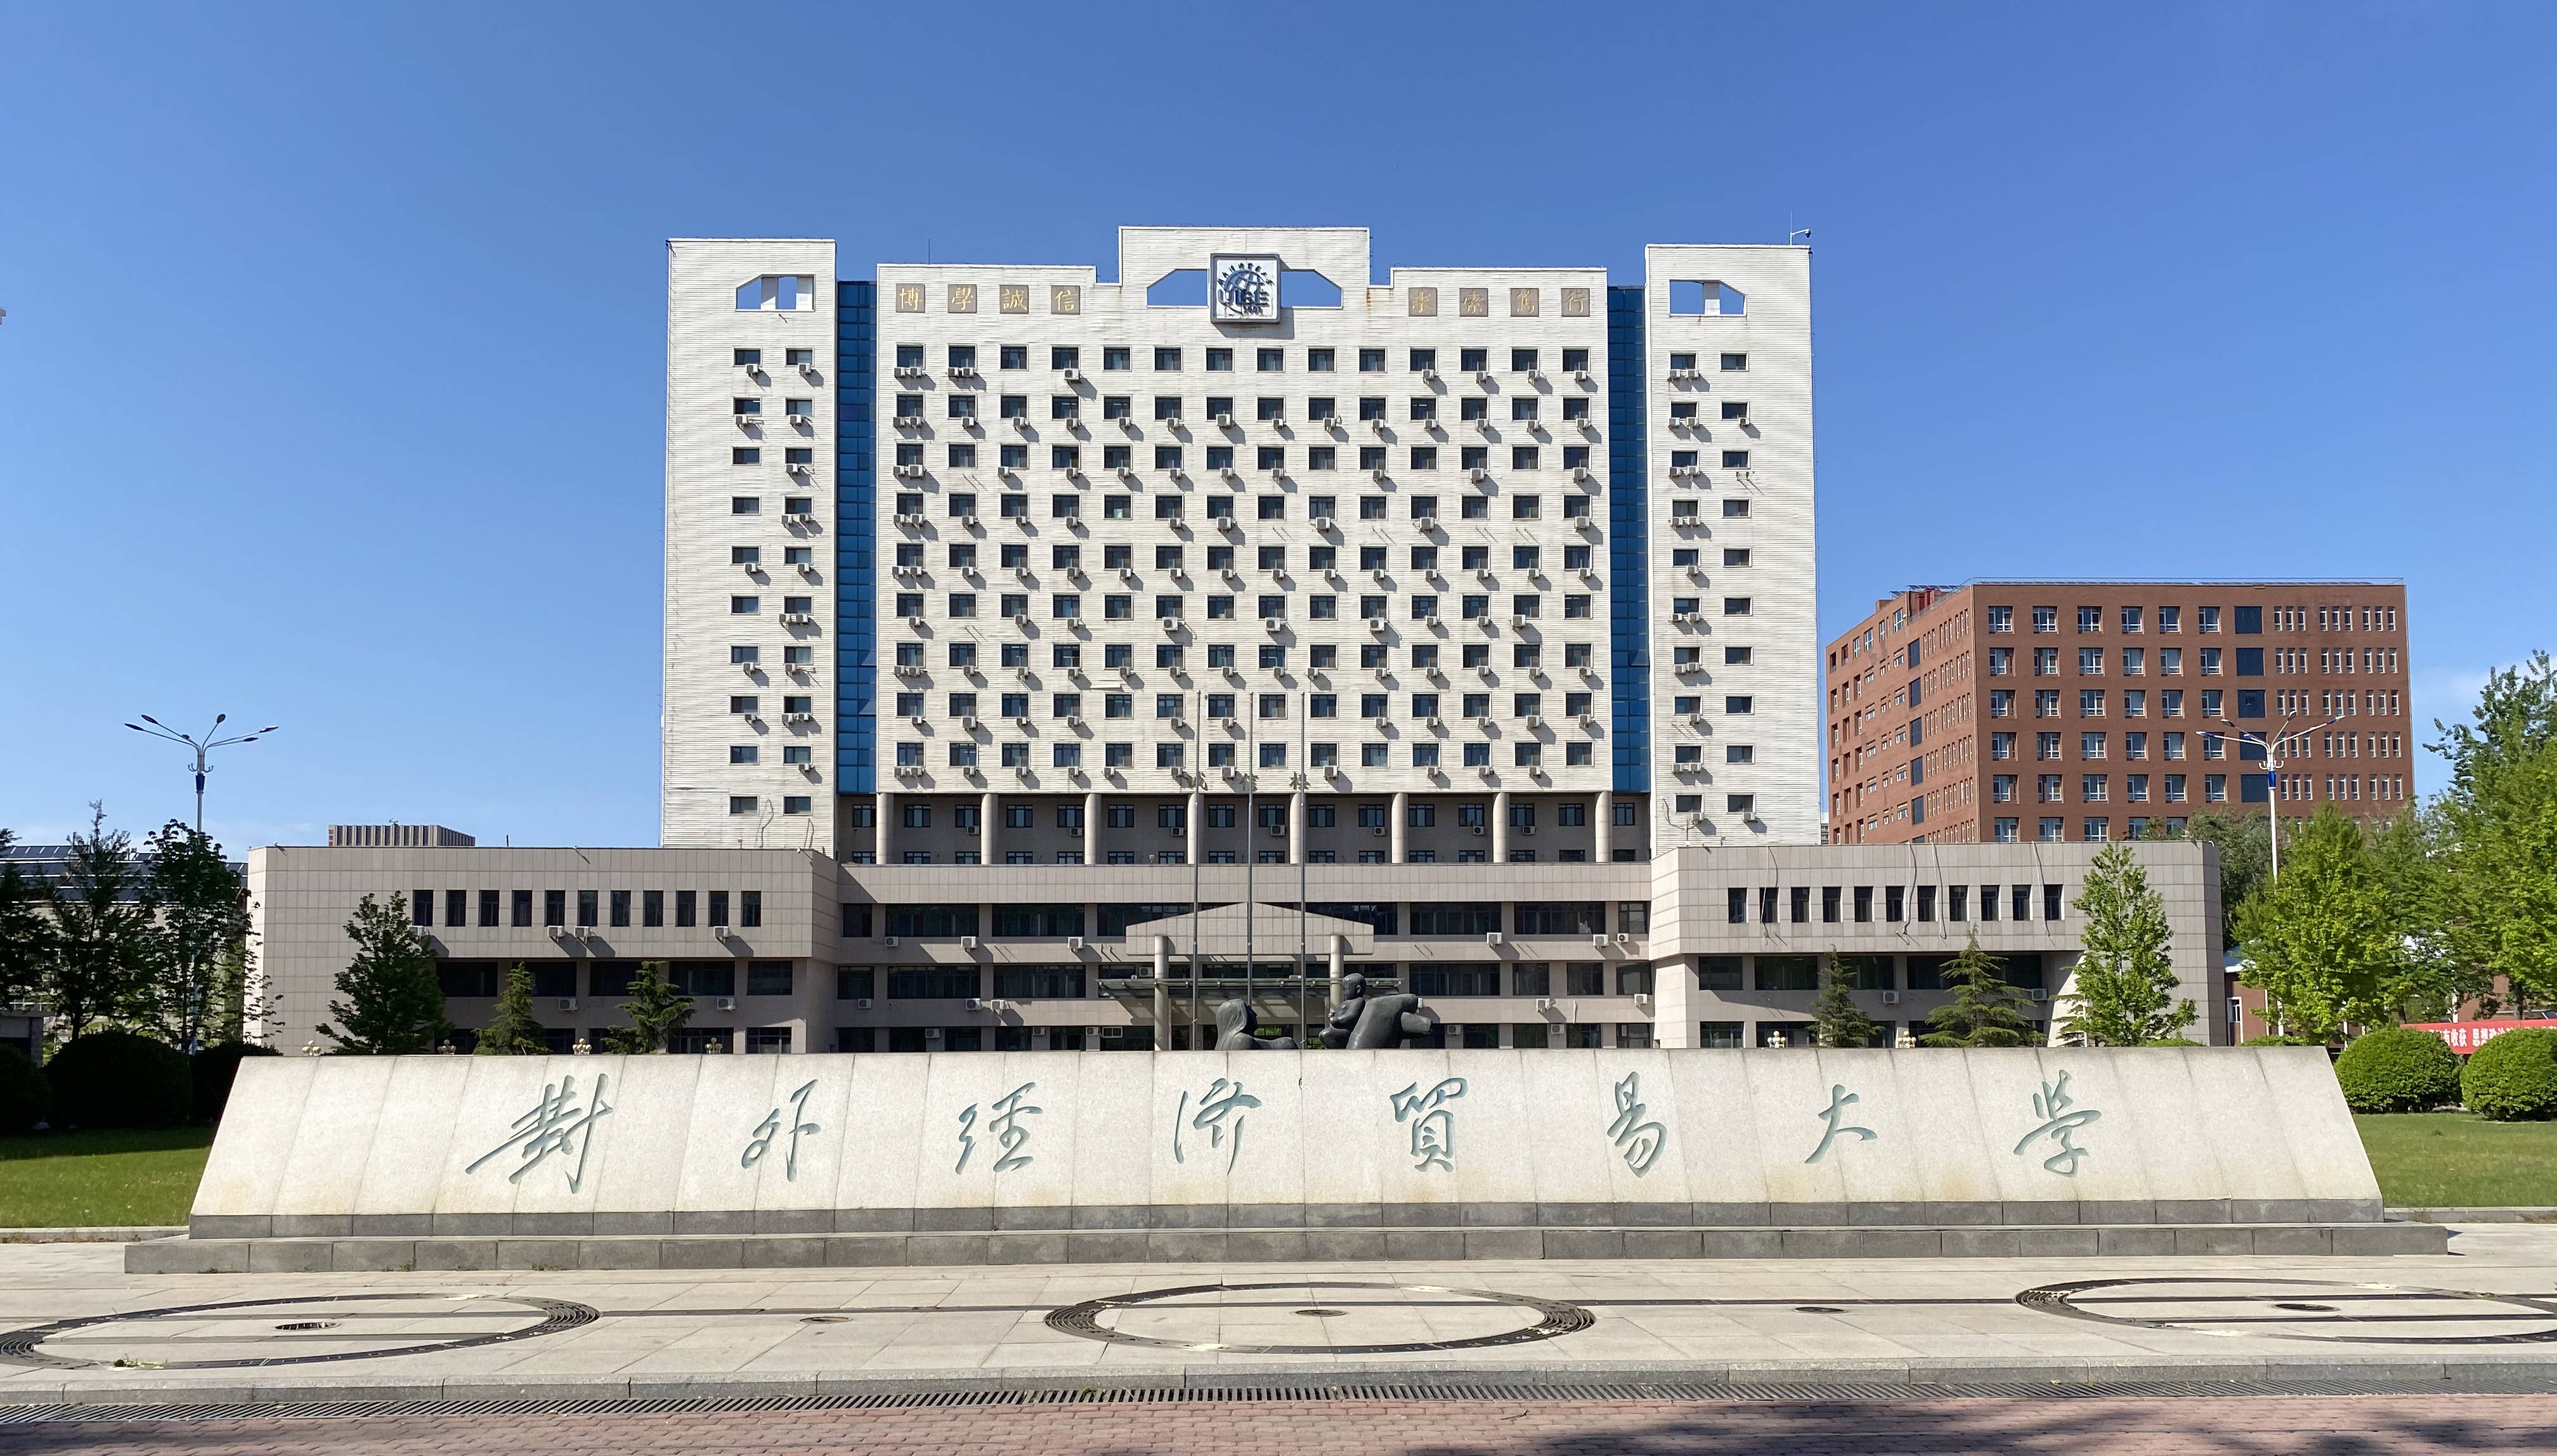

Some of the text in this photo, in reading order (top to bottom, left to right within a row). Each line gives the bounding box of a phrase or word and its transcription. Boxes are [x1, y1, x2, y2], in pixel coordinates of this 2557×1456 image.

[899, 287, 1078, 311] 博學誠信
[1412, 289, 1587, 314] 求索篤行
